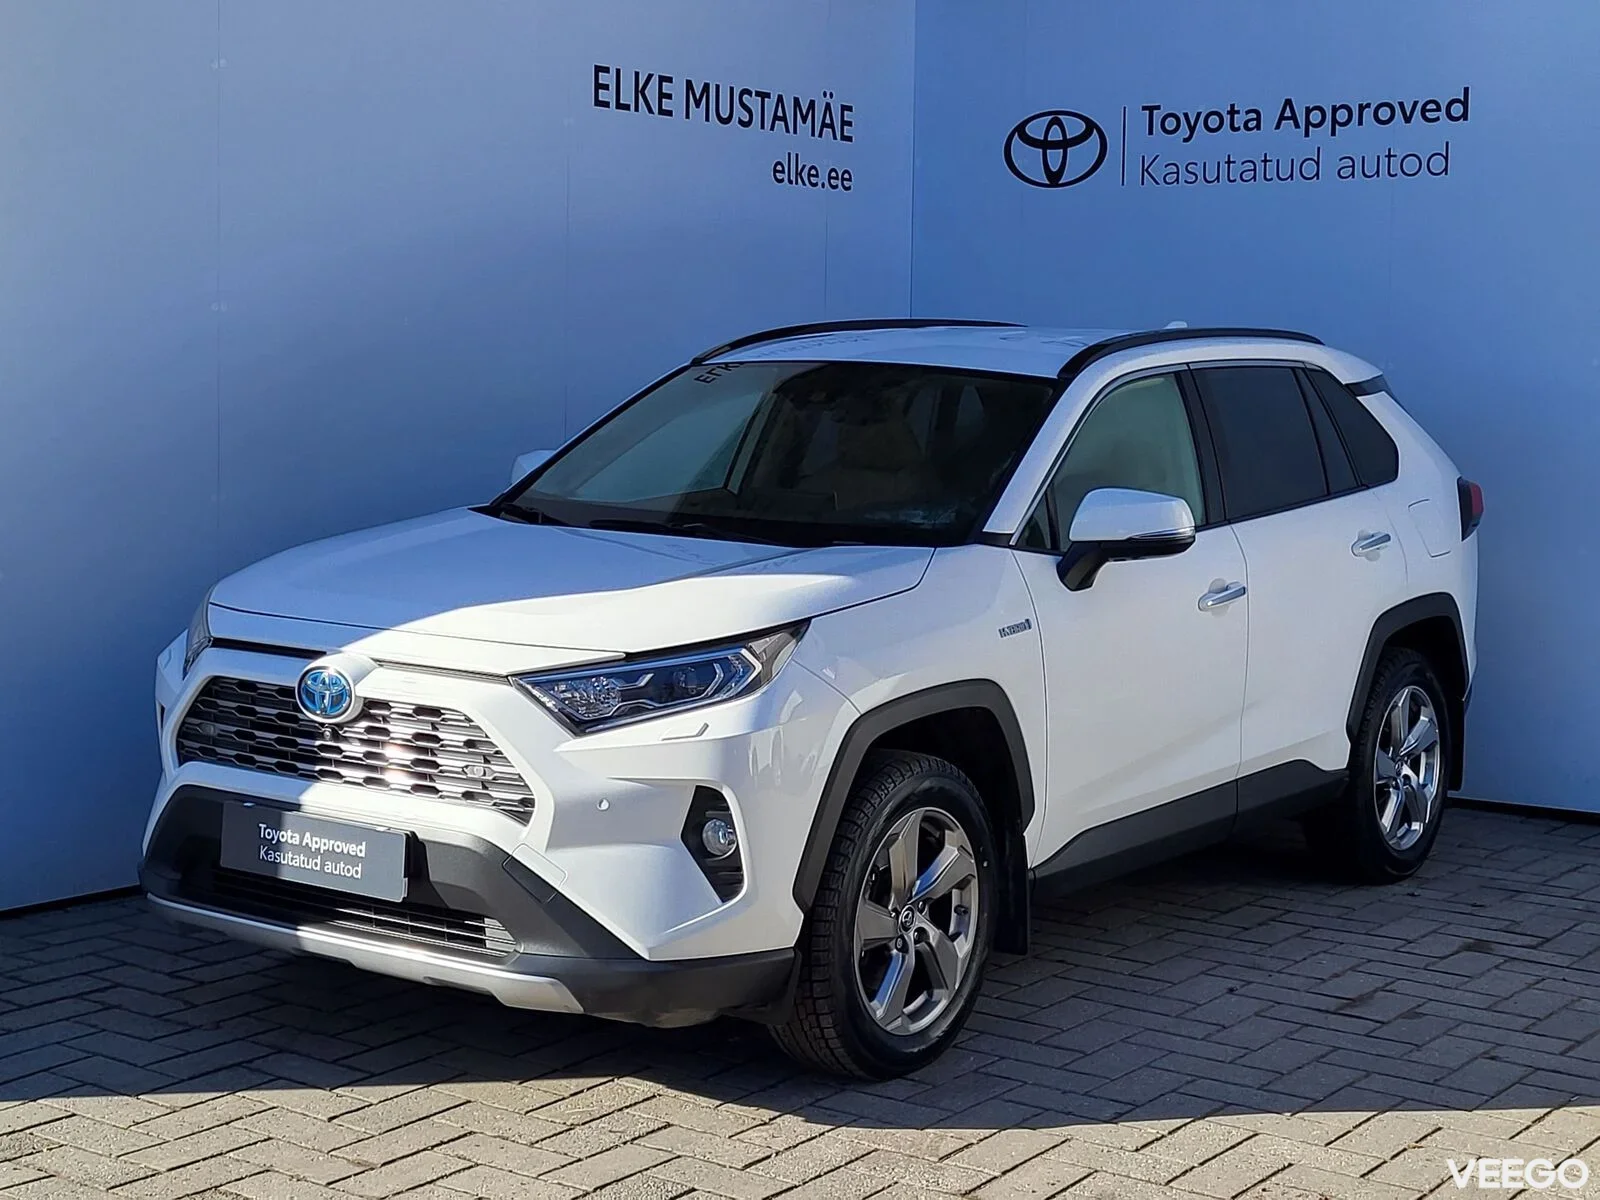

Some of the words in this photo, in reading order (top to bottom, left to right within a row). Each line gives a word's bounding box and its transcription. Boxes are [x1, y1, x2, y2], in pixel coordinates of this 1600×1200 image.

[593, 64, 674, 118] ELKE
[685, 79, 854, 143] MUSTAMÄE
[1142, 103, 1263, 143] Toyota
[1274, 87, 1471, 138] Approved
[772, 151, 853, 192] elke.ee
[1140, 146, 1322, 187] Kasutatud
[1337, 141, 1451, 181] autod
[258, 823, 300, 844] Toyota
[302, 831, 367, 858] Approved
[259, 845, 321, 872] Kasutatud
[323, 861, 363, 879] autod
